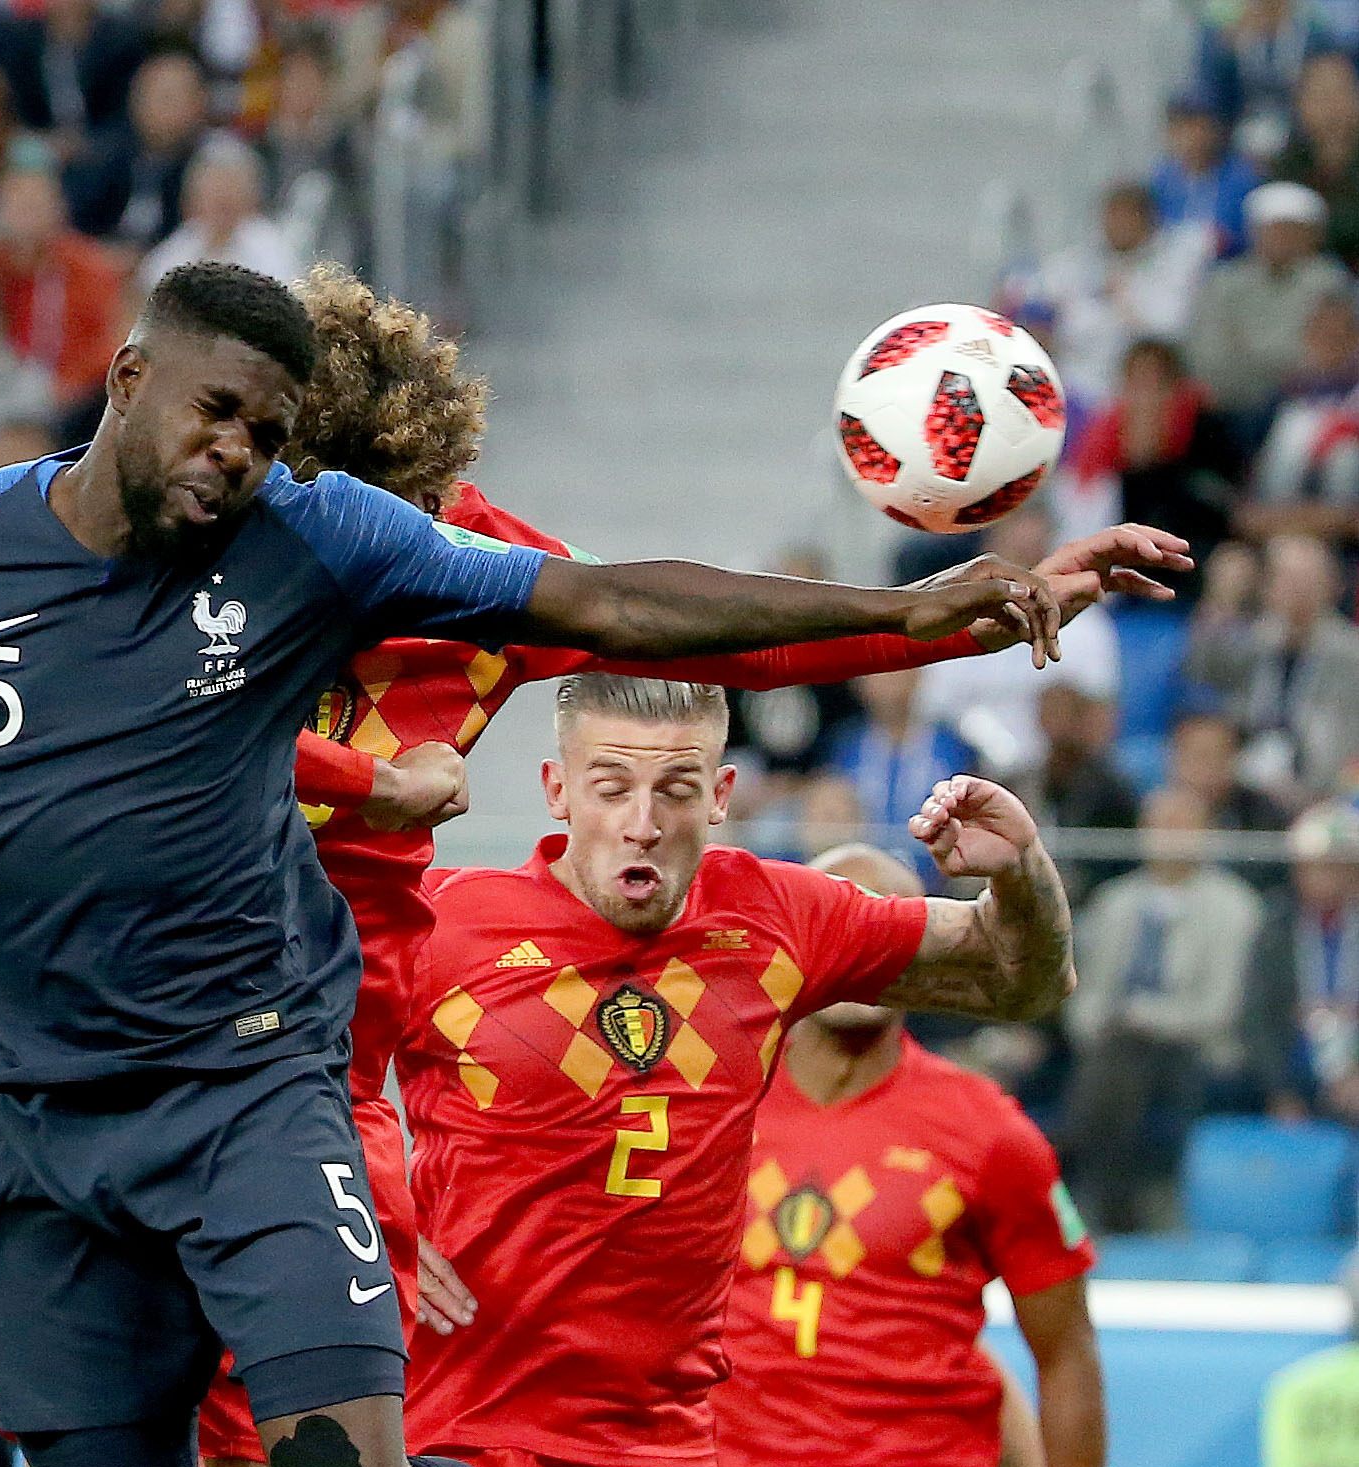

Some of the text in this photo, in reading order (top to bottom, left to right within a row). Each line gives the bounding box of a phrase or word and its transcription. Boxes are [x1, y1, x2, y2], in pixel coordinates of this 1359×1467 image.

[604, 1095, 670, 1198] 2
[320, 1162, 381, 1263] 5
[770, 1265, 823, 1359] 4
